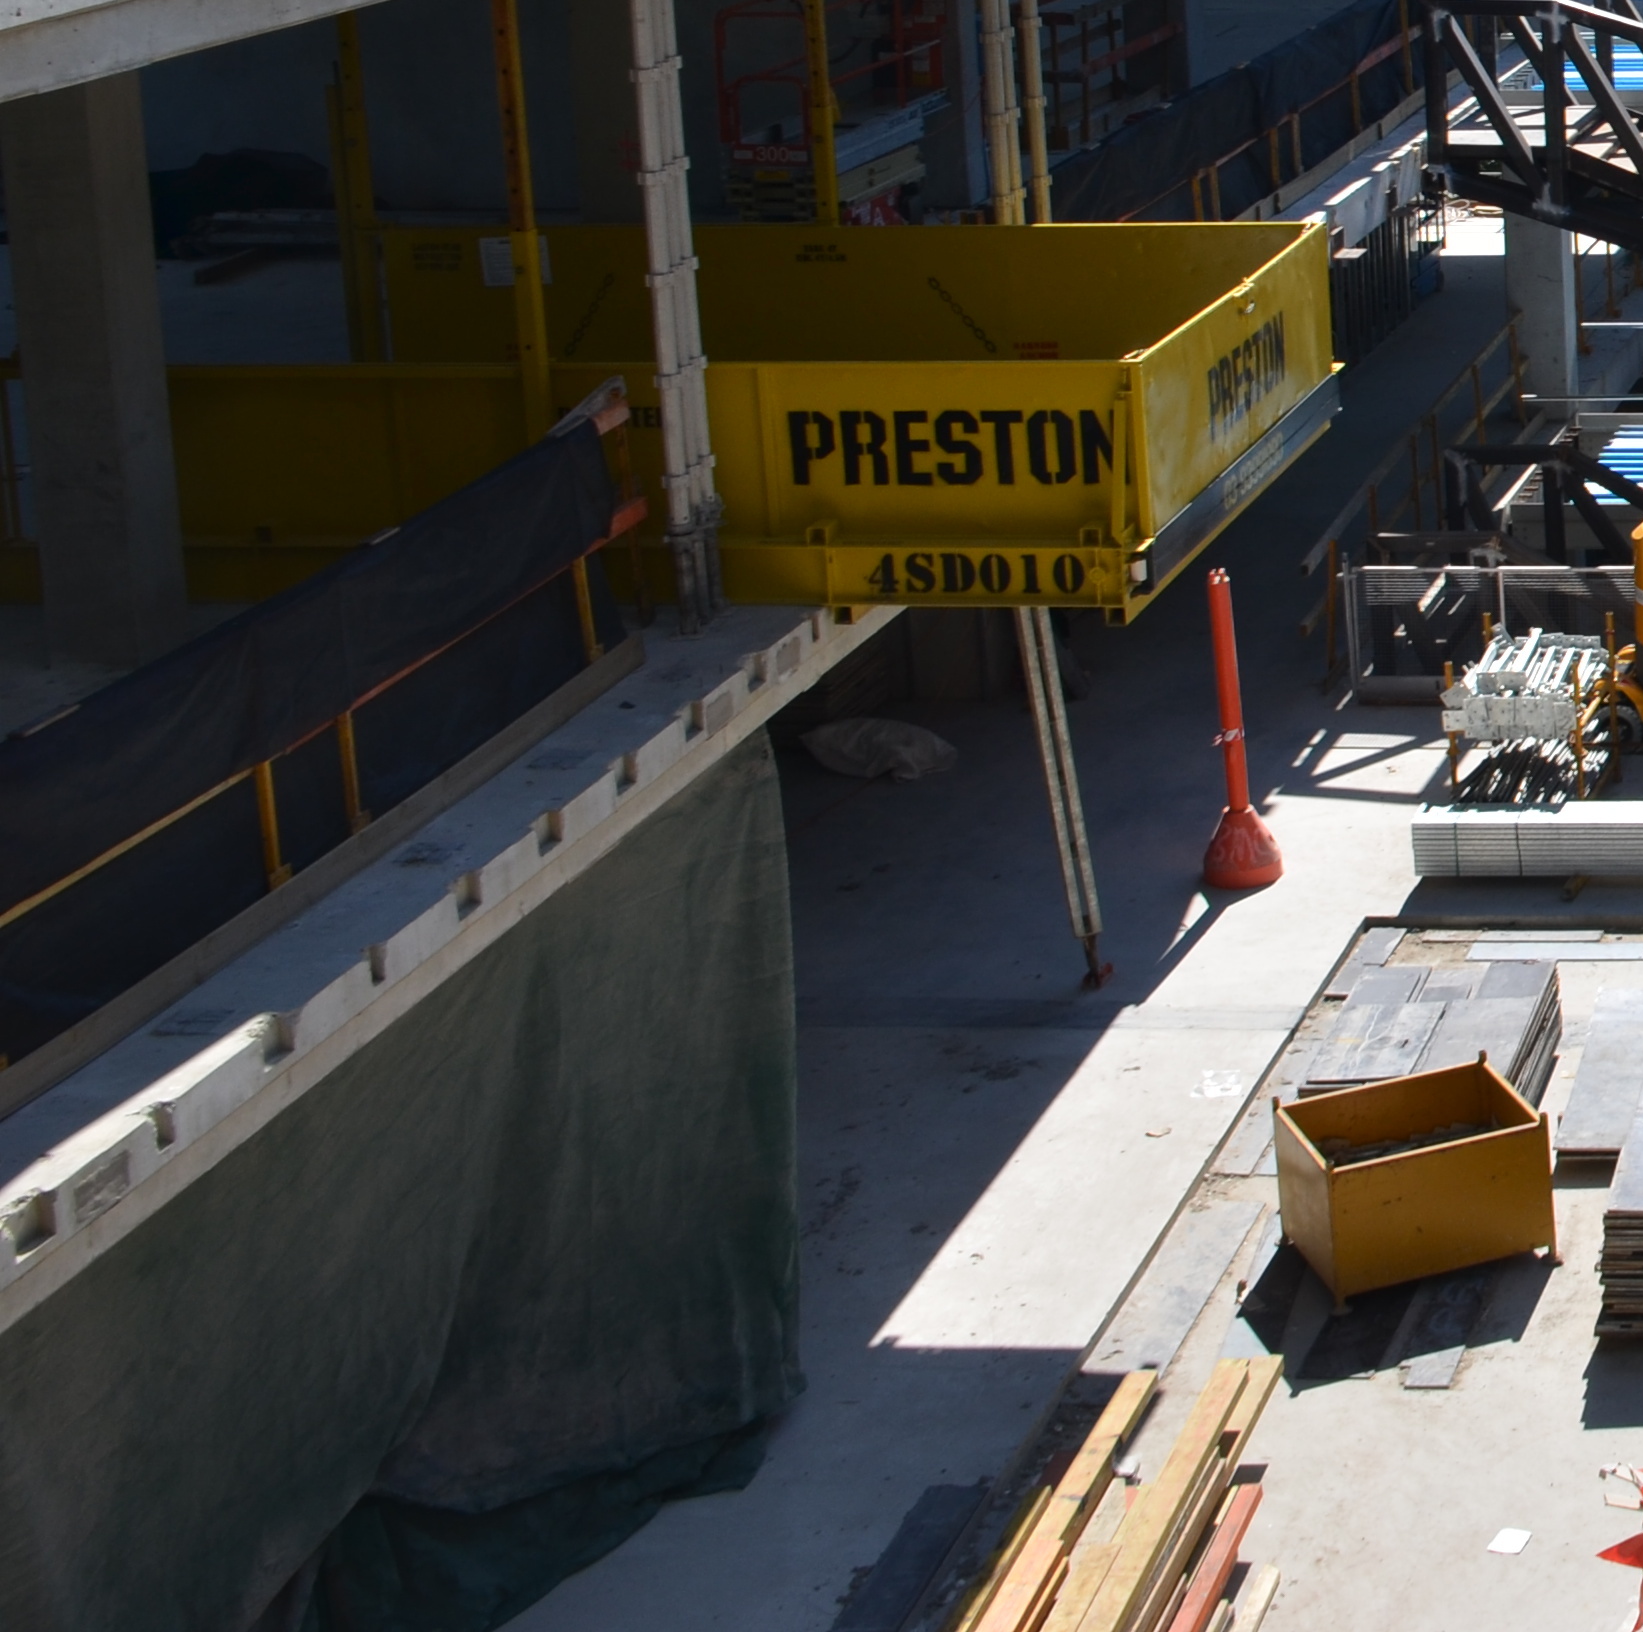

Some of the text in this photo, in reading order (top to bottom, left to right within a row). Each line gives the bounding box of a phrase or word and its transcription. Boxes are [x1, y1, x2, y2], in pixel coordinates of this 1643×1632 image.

[755, 145, 789, 163] 300
[1207, 310, 1285, 442] PRESTON
[787, 408, 1131, 486] PRESTON
[867, 551, 1086, 595] 4SD010
